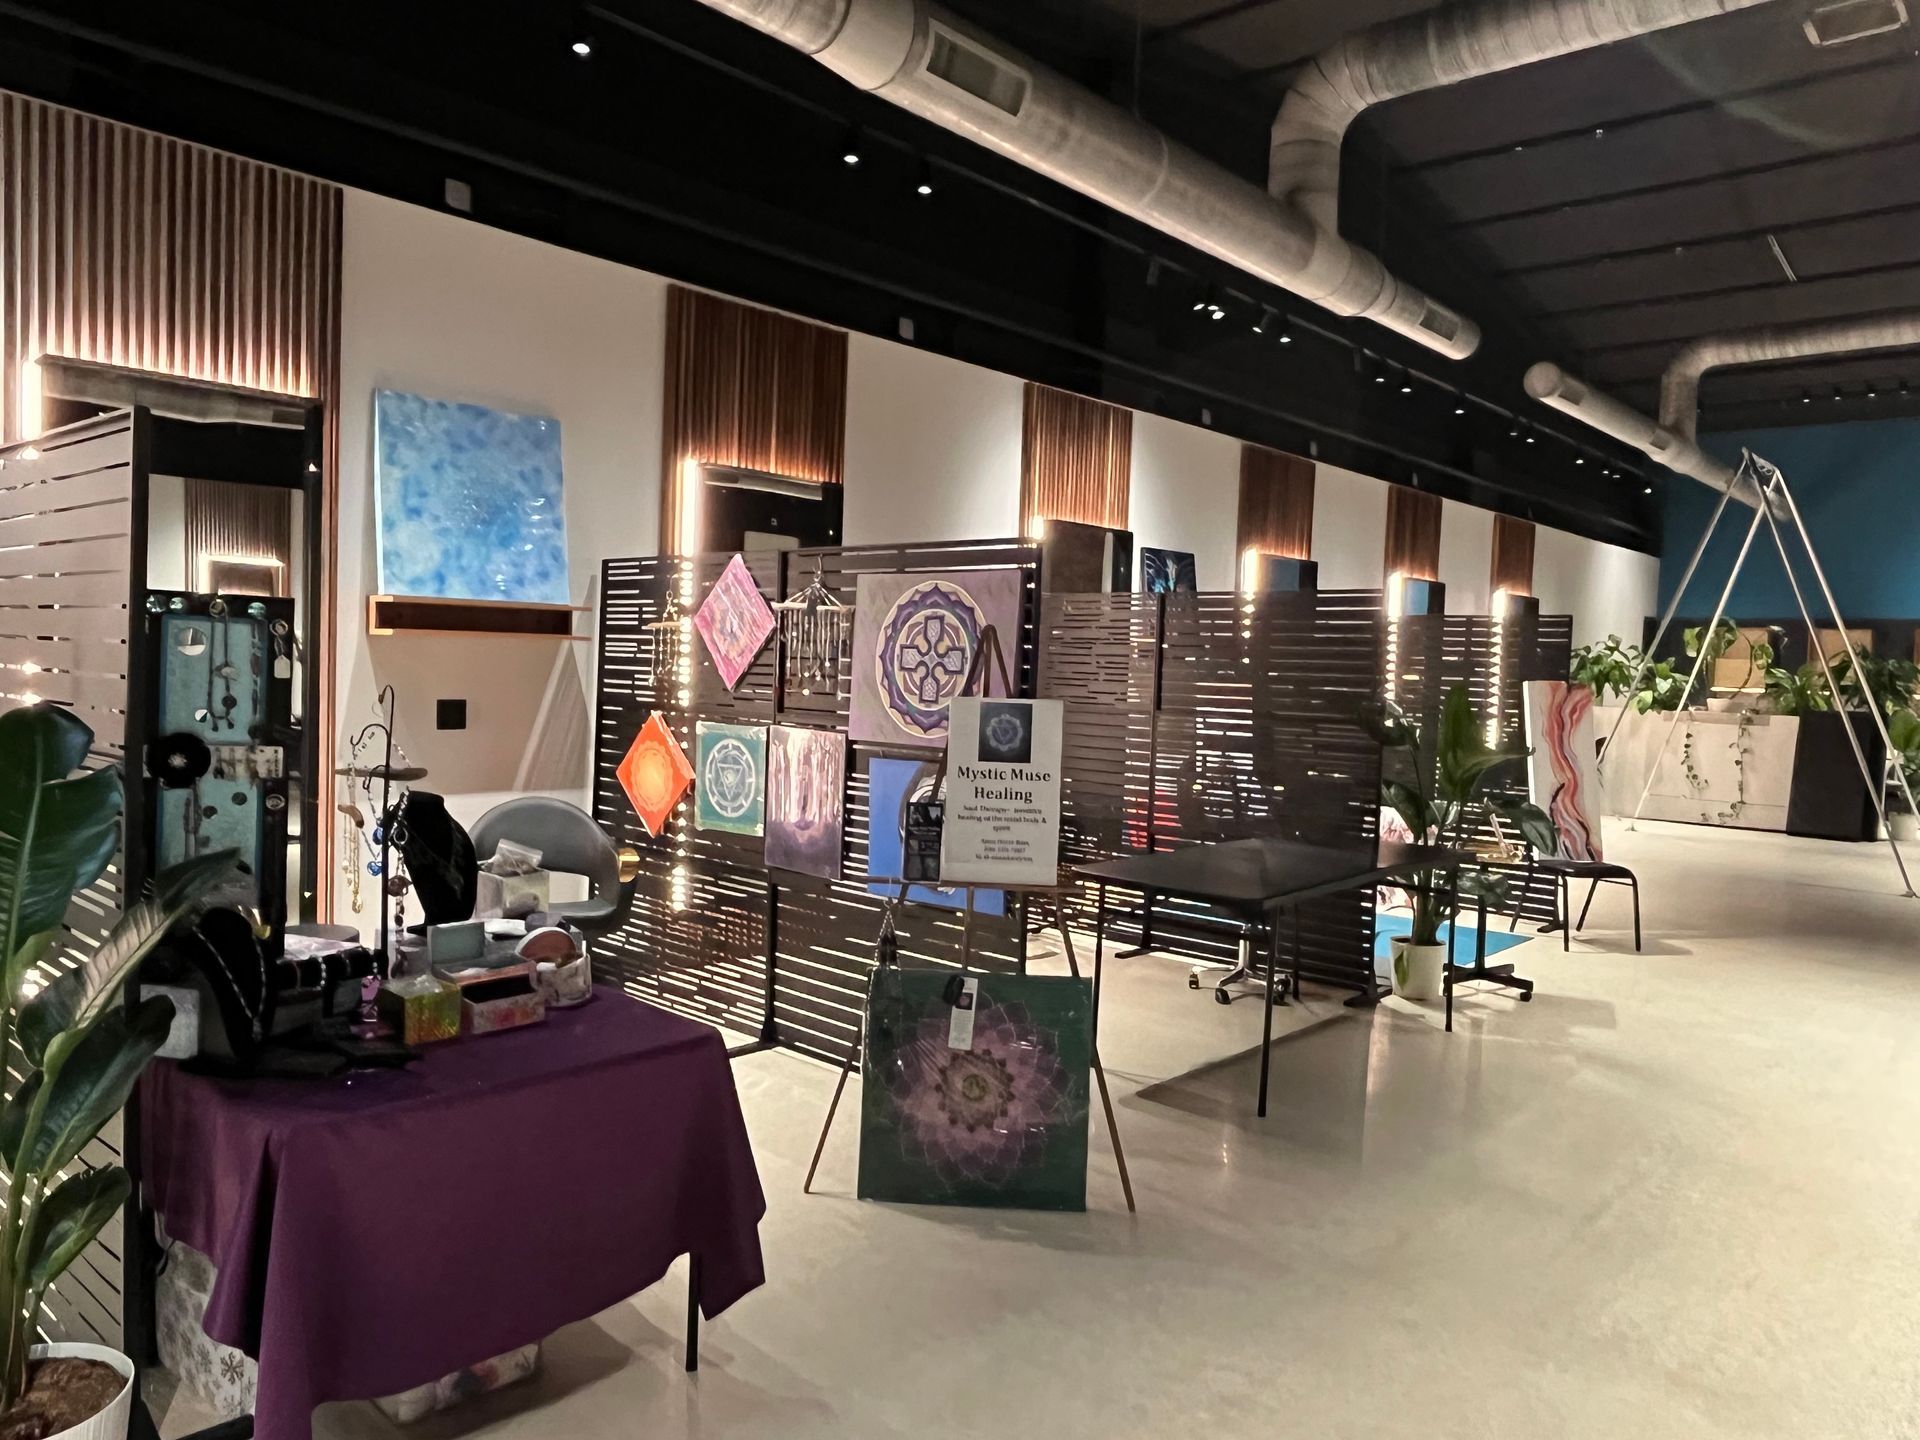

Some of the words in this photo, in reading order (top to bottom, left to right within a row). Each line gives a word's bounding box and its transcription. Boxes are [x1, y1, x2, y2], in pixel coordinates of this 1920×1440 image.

[958, 766, 1007, 782] Mystic
[1011, 768, 1051, 782] Muse
[975, 786, 1032, 804] Healing
